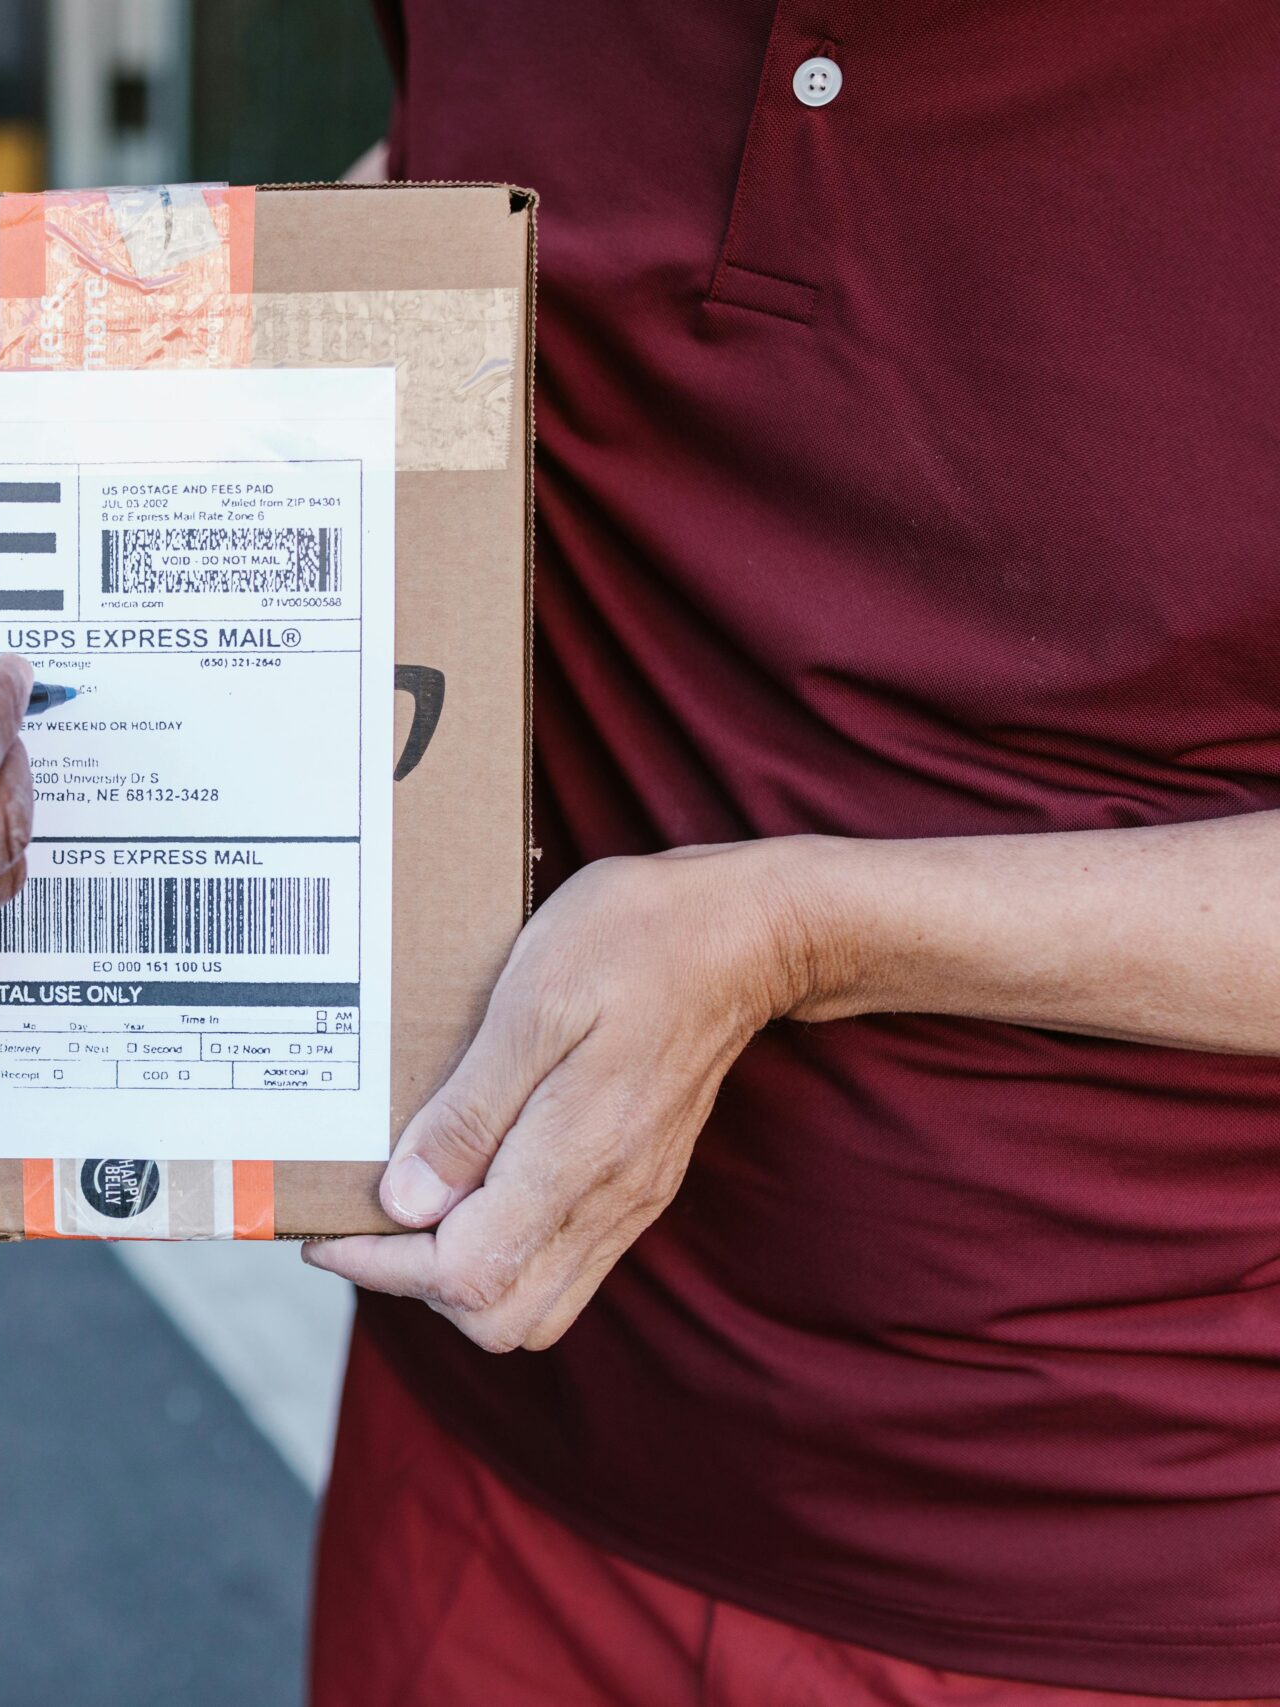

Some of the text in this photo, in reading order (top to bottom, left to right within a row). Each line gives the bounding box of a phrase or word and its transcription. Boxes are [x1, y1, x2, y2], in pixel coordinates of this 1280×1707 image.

[29, 282, 65, 366] less.
[101, 484, 274, 496] US POSTAGE AND FEES PAID
[101, 498, 169, 509] JUL 03 2002
[221, 497, 341, 508] Mailed from ZIP 94301
[111, 513, 125, 522] oz
[127, 511, 170, 523] Express
[173, 511, 196, 521] Mail
[198, 511, 224, 521] Rate
[227, 510, 255, 521] Zone
[257, 510, 265, 521] 6
[161, 555, 191, 566] VOID
[201, 555, 220, 566] DO
[222, 555, 248, 566] NOT
[251, 555, 281, 566] MAIL
[7, 629, 76, 649] USPS
[86, 629, 209, 649] EXPRESS
[48, 658, 92, 671] Postage
[199, 656, 282, 669] (650) 321-2640
[45, 721, 107, 731] WEEKEND
[109, 721, 128, 731] OR
[131, 720, 183, 731] HOLIDAY
[62, 756, 99, 768] Smith
[63, 772, 127, 786] University
[131, 772, 145, 784] Dr
[150, 772, 159, 784] S
[96, 788, 120, 802] NE
[126, 788, 219, 802] 68132-3428
[51, 849, 264, 866] USPS EXPRESS MAIL
[92, 960, 223, 973] EO 000 161 100 US
[39, 984, 83, 1003] USE
[86, 985, 142, 1004] ONLY
[180, 1014, 219, 1024] Time In
[335, 1011, 352, 1020] AM
[123, 1022, 145, 1030] Year
[335, 1022, 352, 1032] PM
[0, 1043, 41, 1054] Delivery
[143, 1044, 182, 1054] Second
[227, 1045, 271, 1054] 12 Noon
[306, 1045, 333, 1054] 3 PM
[1, 1070, 40, 1080] Receipt
[142, 1071, 169, 1080] COD
[105, 1166, 122, 1205] BELLY
[119, 1160, 141, 1203] HAPPY
